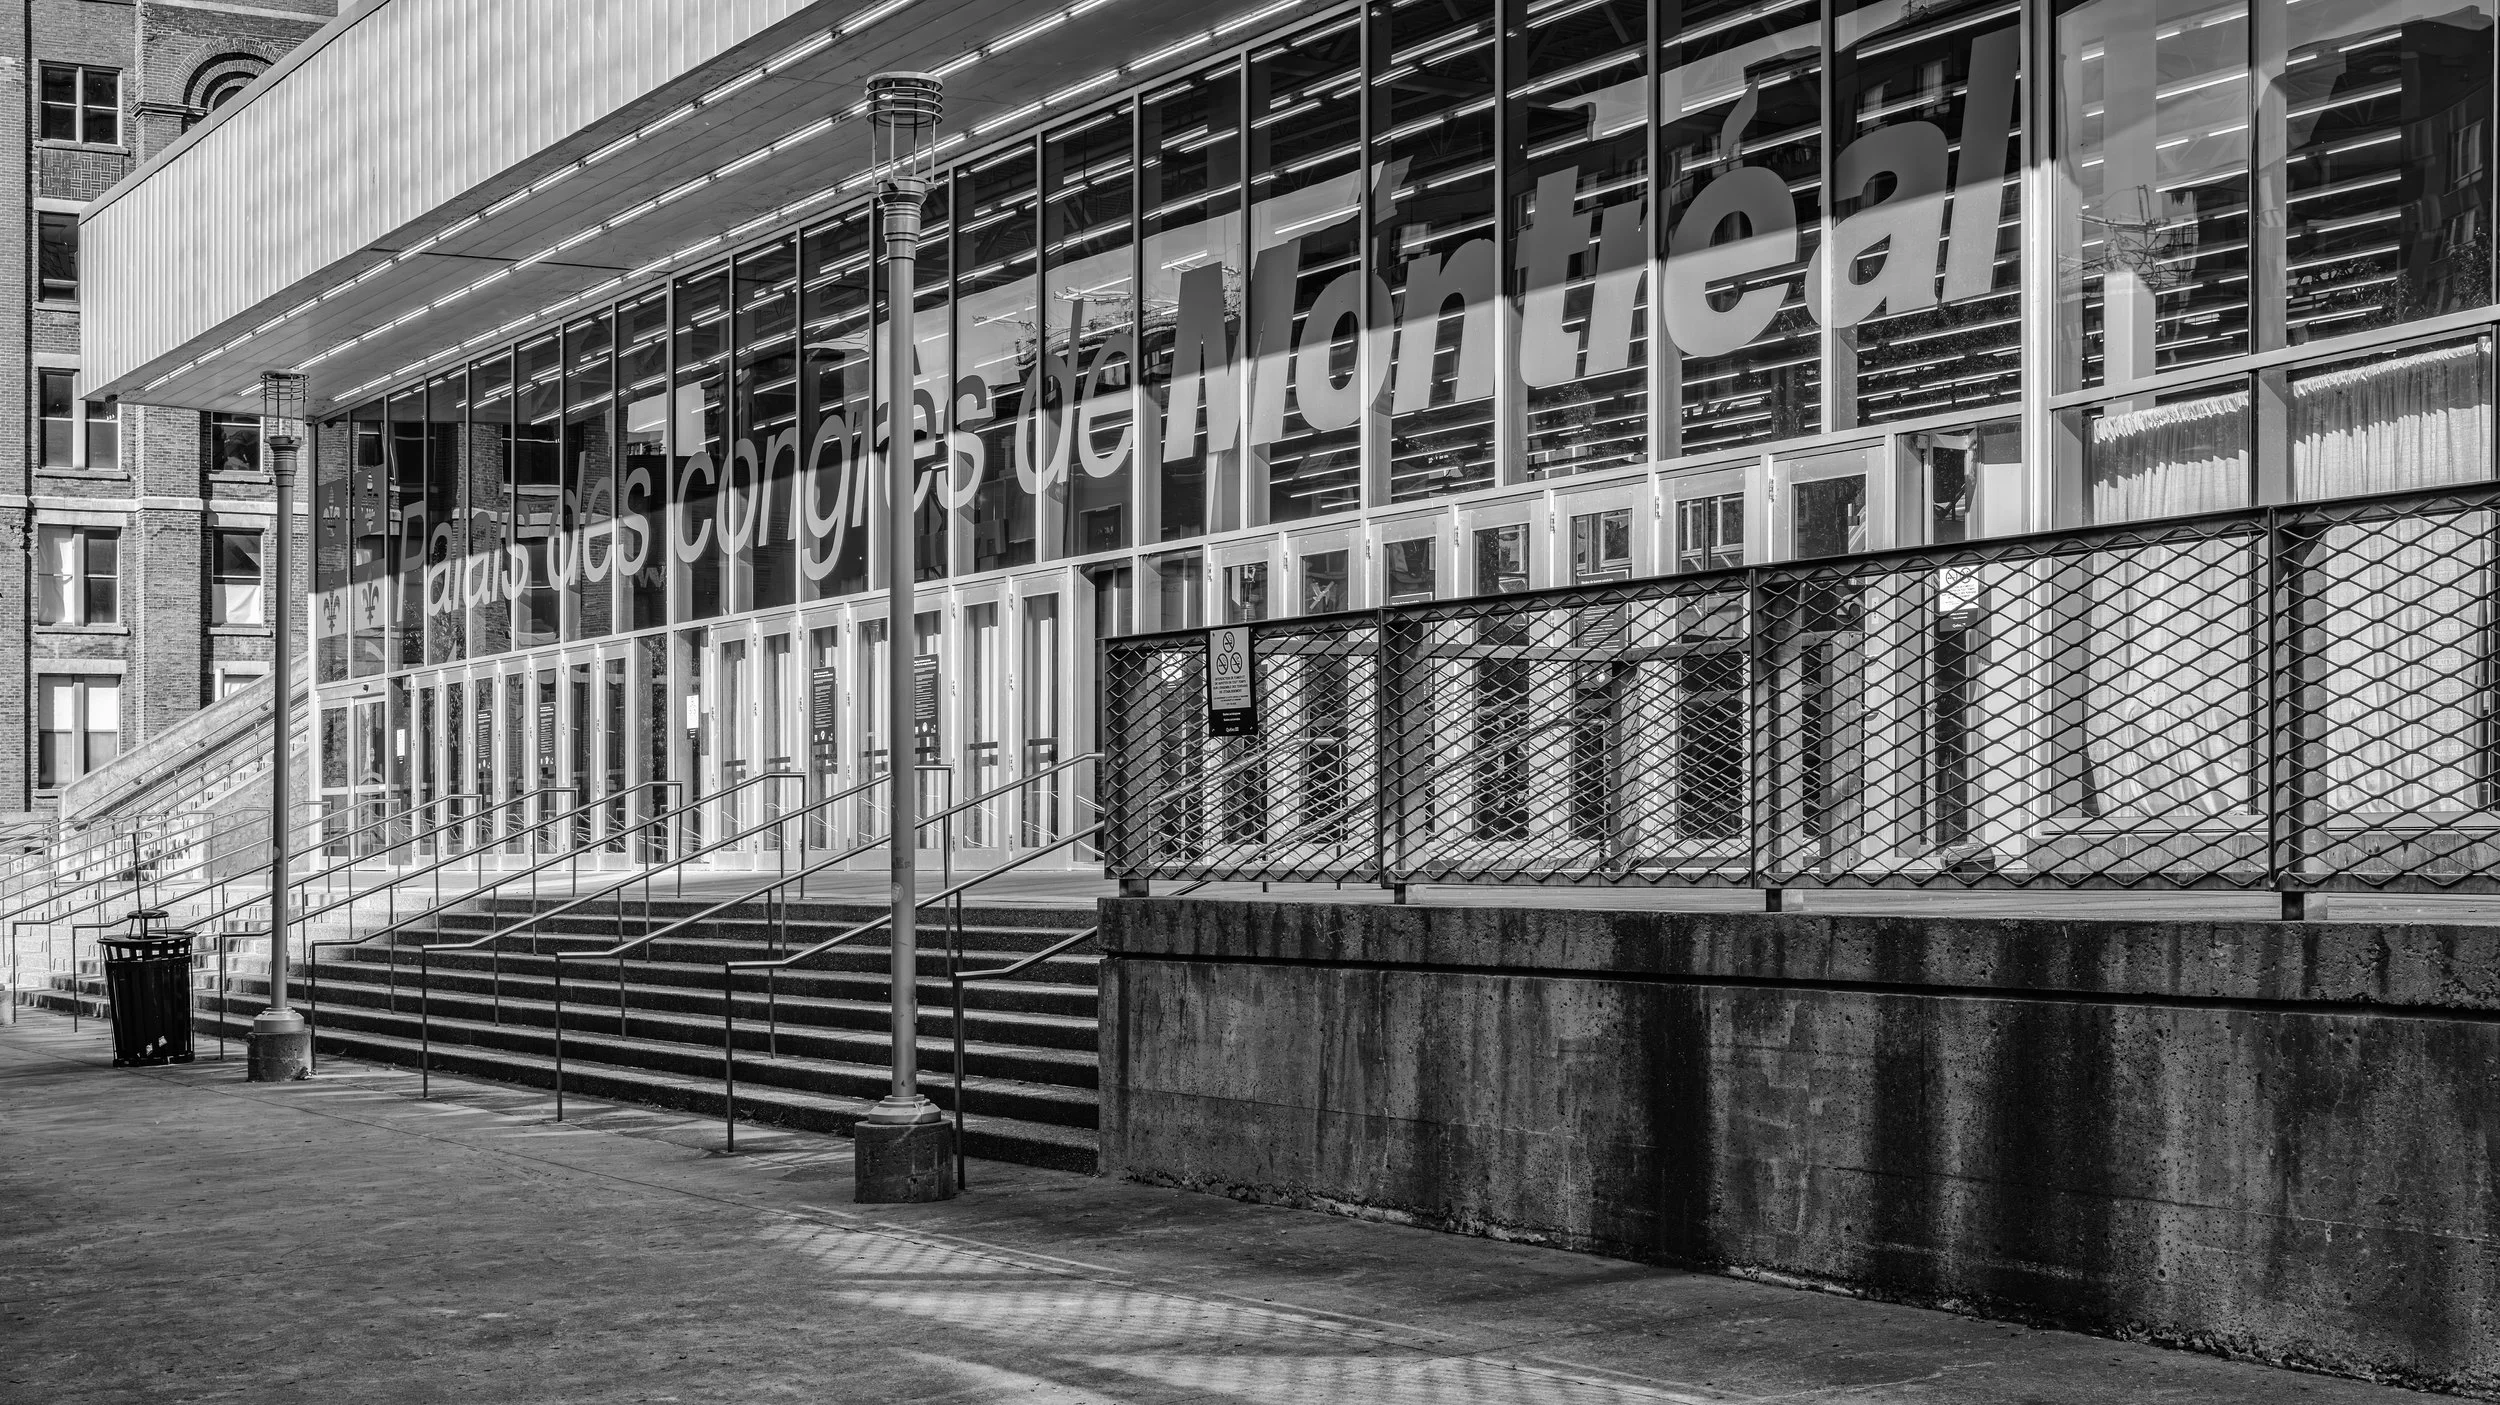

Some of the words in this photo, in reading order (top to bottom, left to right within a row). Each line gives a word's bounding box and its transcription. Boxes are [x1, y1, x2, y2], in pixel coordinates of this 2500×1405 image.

[396, 482, 530, 622] Palais
[547, 451, 651, 590] des
[1015, 300, 1134, 494] de
[1164, 25, 2020, 462] Montréal
